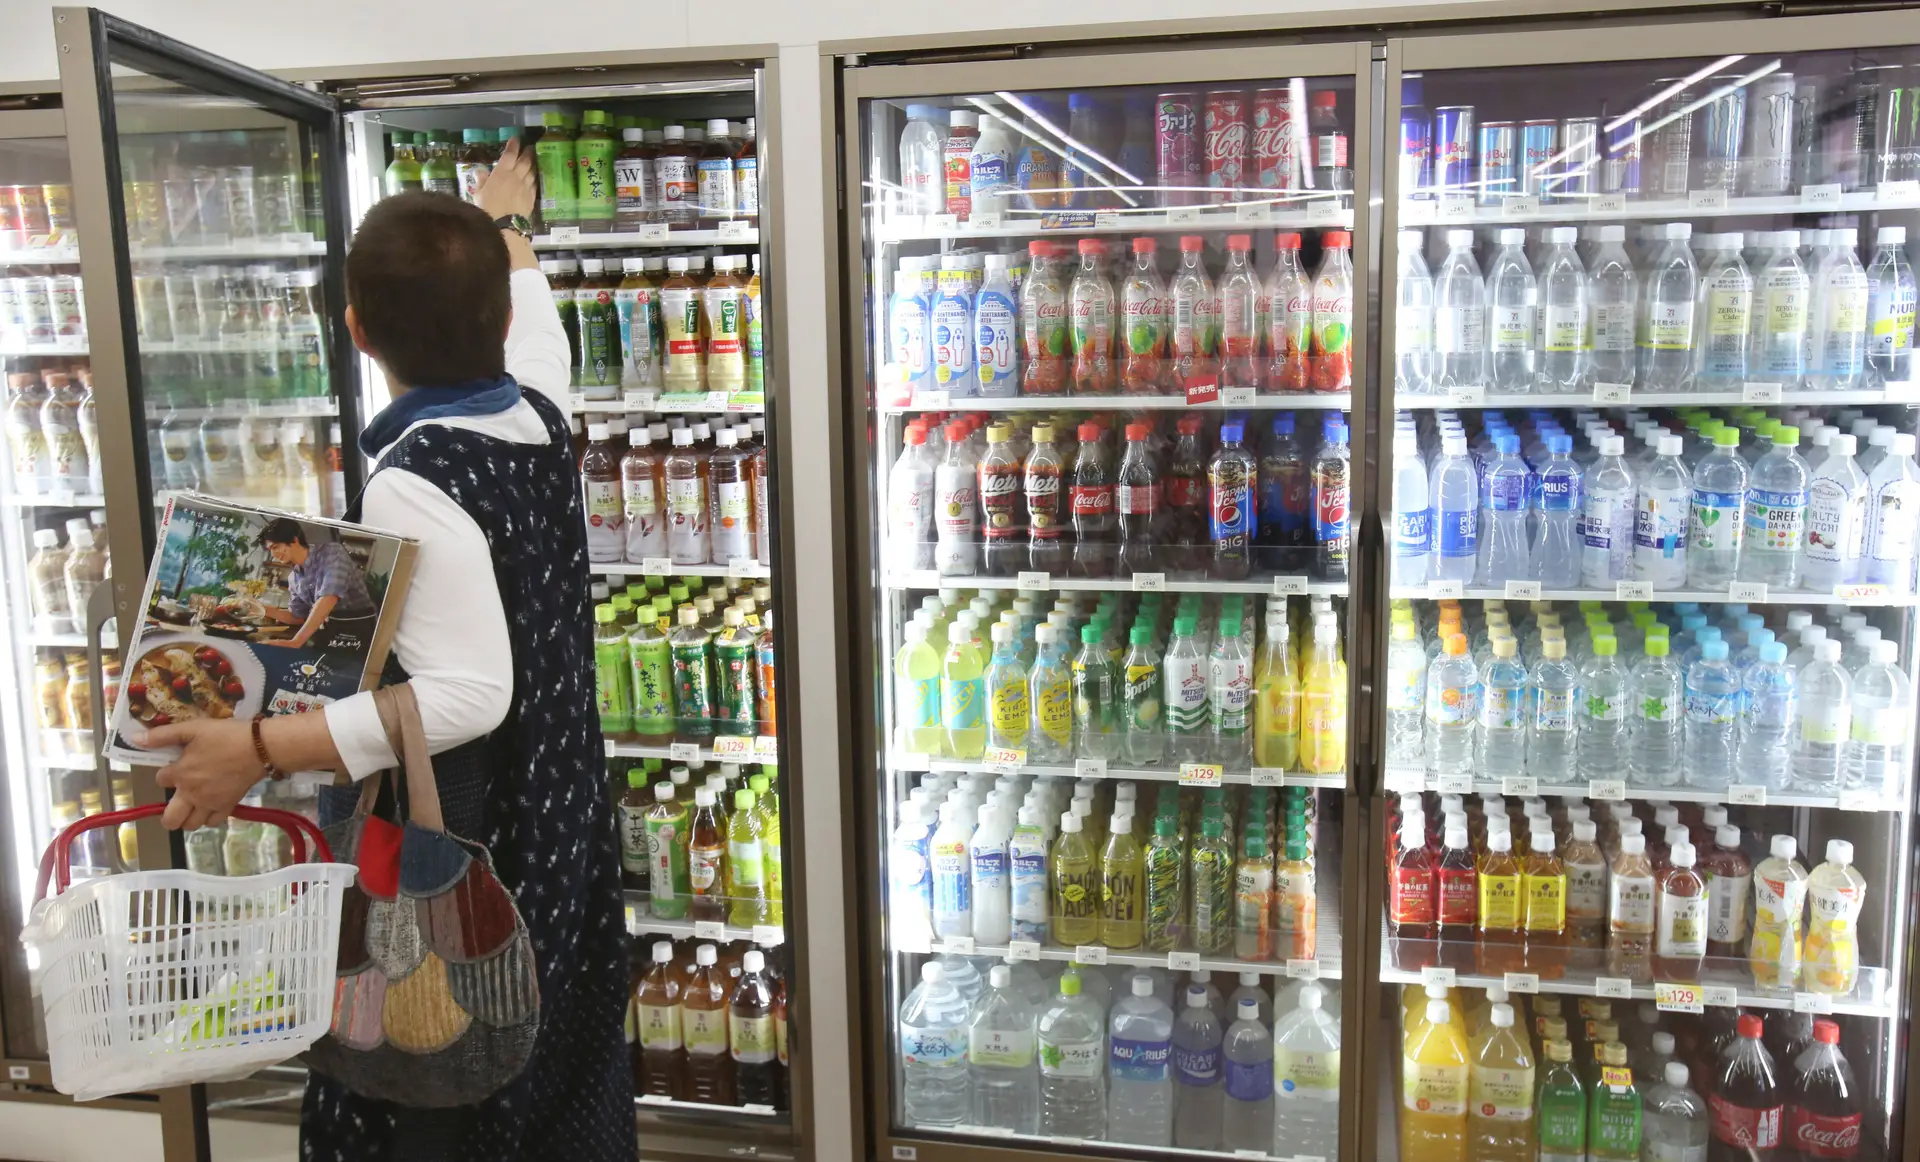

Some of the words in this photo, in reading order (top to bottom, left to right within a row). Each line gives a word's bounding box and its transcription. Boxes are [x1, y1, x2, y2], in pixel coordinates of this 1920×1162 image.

[1452, 142, 1470, 153] Bull
[1493, 148, 1512, 158] Bull
[1528, 148, 1547, 158] Red
[622, 168, 641, 183] W
[973, 166, 1000, 174] カルピス
[973, 174, 1000, 182] ウォーター
[1120, 298, 1162, 316] Coca-Cola
[1188, 384, 1216, 395] 新発売
[984, 474, 1018, 491] Mets
[1024, 475, 1059, 492] Mets
[1074, 492, 1112, 508] Coca-Cola
[1214, 485, 1248, 508] JAPAN
[1224, 494, 1246, 507] Cola
[1222, 528, 1240, 536] pepsi
[1219, 536, 1244, 551] BIG
[1328, 538, 1350, 552] BIG
[1124, 672, 1156, 700] Sprite
[1184, 694, 1204, 702] CIDER
[994, 752, 1016, 762] ¥129
[1189, 768, 1214, 780] ¥129
[629, 814, 646, 849] 十六茶
[1668, 990, 1694, 1004] ¥129
[913, 1042, 955, 1057] 天然水
[1114, 1044, 1166, 1064] AQUARIUS
[1798, 1122, 1860, 1148] Coca-Cola
